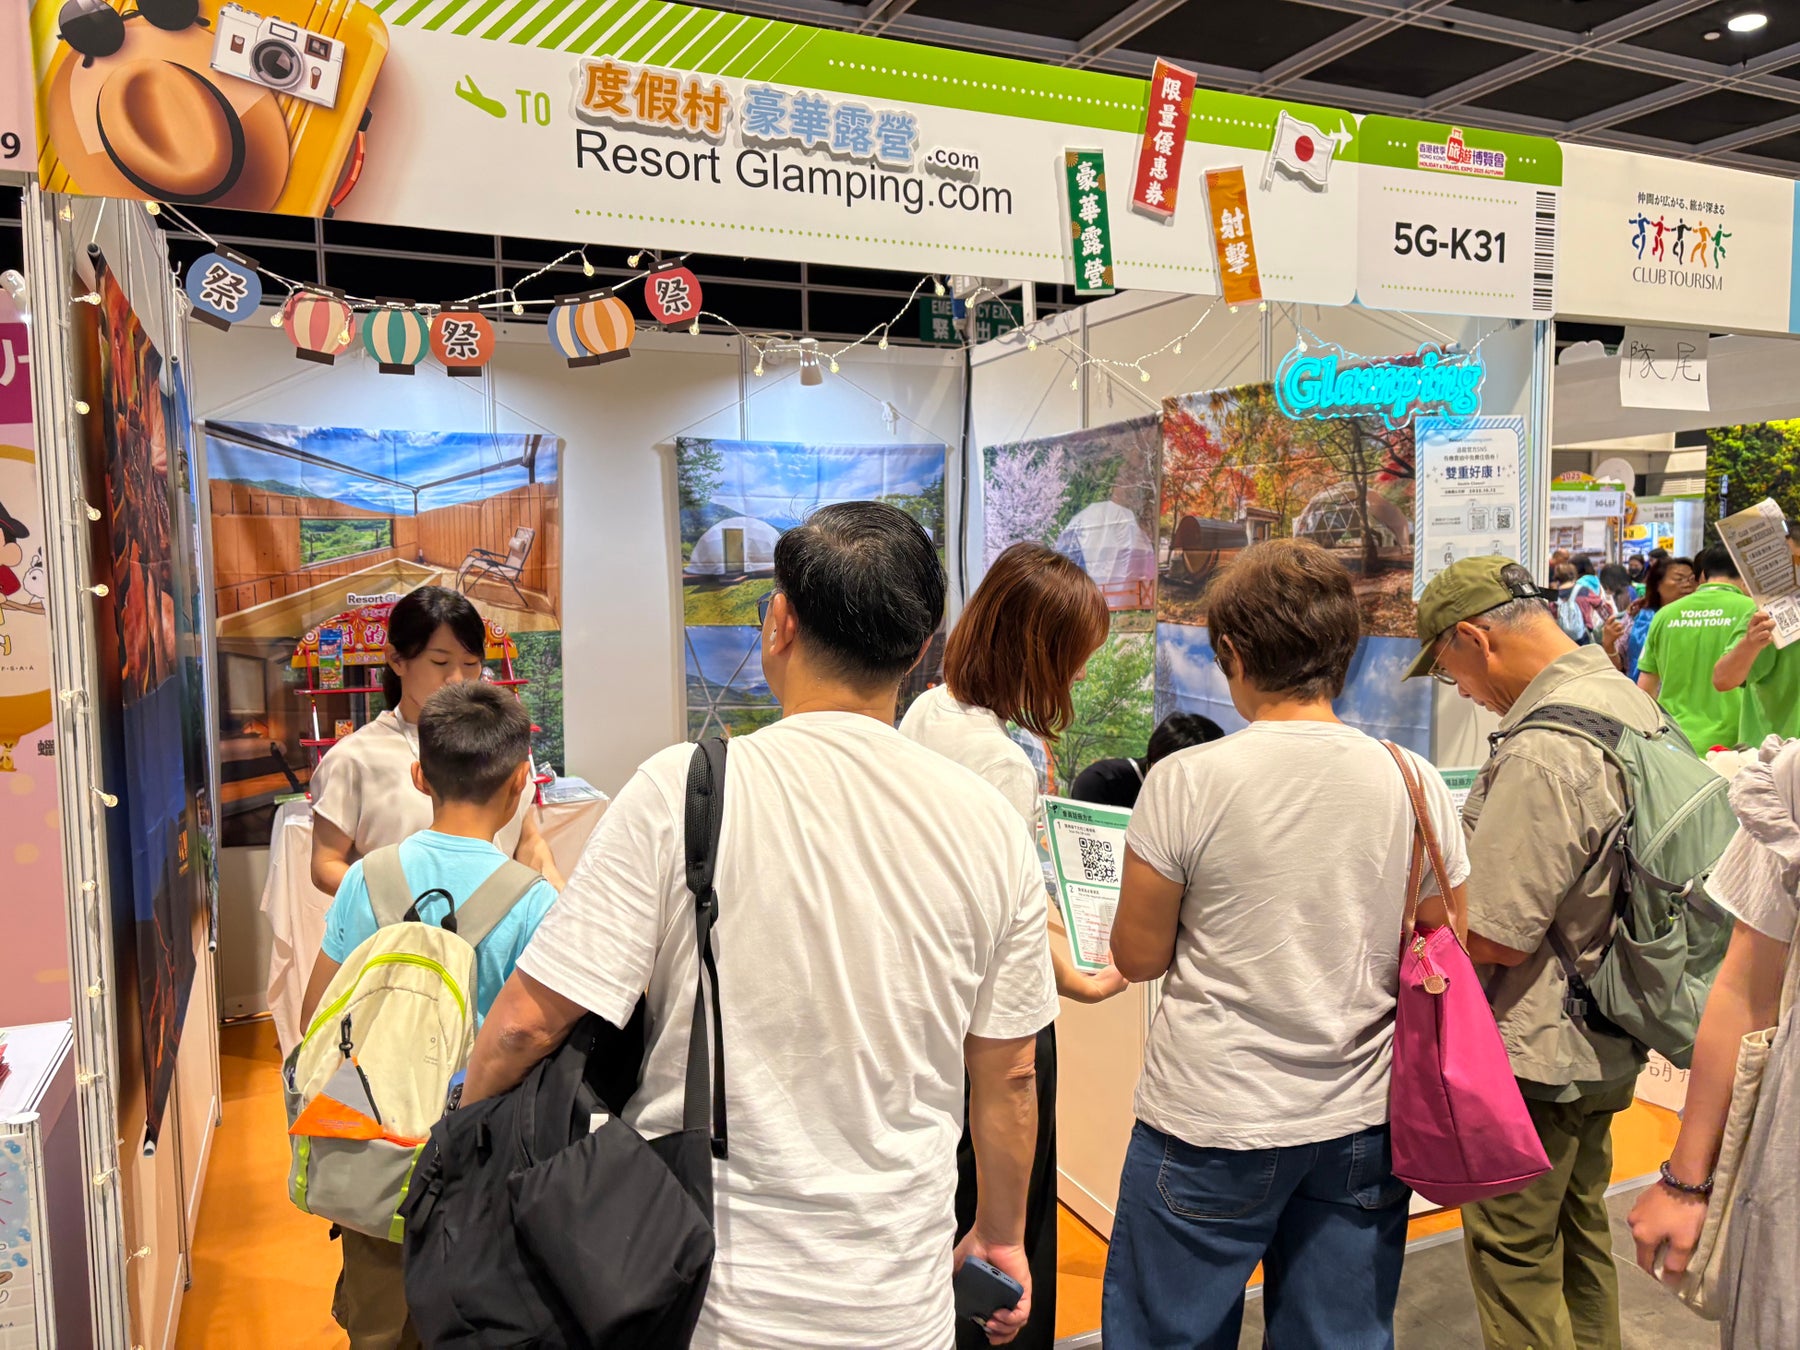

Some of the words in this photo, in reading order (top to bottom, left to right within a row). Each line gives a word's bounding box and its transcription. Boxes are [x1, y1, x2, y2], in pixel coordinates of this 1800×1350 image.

[515, 89, 551, 126] TO
[583, 61, 728, 134] 度假村
[744, 87, 917, 162] 豪華露營
[926, 147, 979, 171] .com
[1145, 77, 1182, 206] 限量優惠券
[575, 128, 721, 184] Resort
[735, 149, 1013, 215] Glamping.com
[1075, 161, 1106, 289] 豪華露營
[1219, 206, 1250, 275] 射擊
[1394, 221, 1506, 263] 5G-K31
[200, 263, 248, 313] 祭
[656, 278, 692, 316] 祭
[1632, 266, 1667, 285] CLUB
[1668, 269, 1723, 291] TOURISM
[443, 319, 480, 359] 祭
[1628, 340, 1701, 382] 隊尾
[1284, 350, 1482, 418] Glamping
[348, 594, 384, 605] Resort
[1680, 608, 1724, 618] YOKOSO
[1667, 619, 1703, 628] JAPAN
[1703, 617, 1732, 627] TOUR
